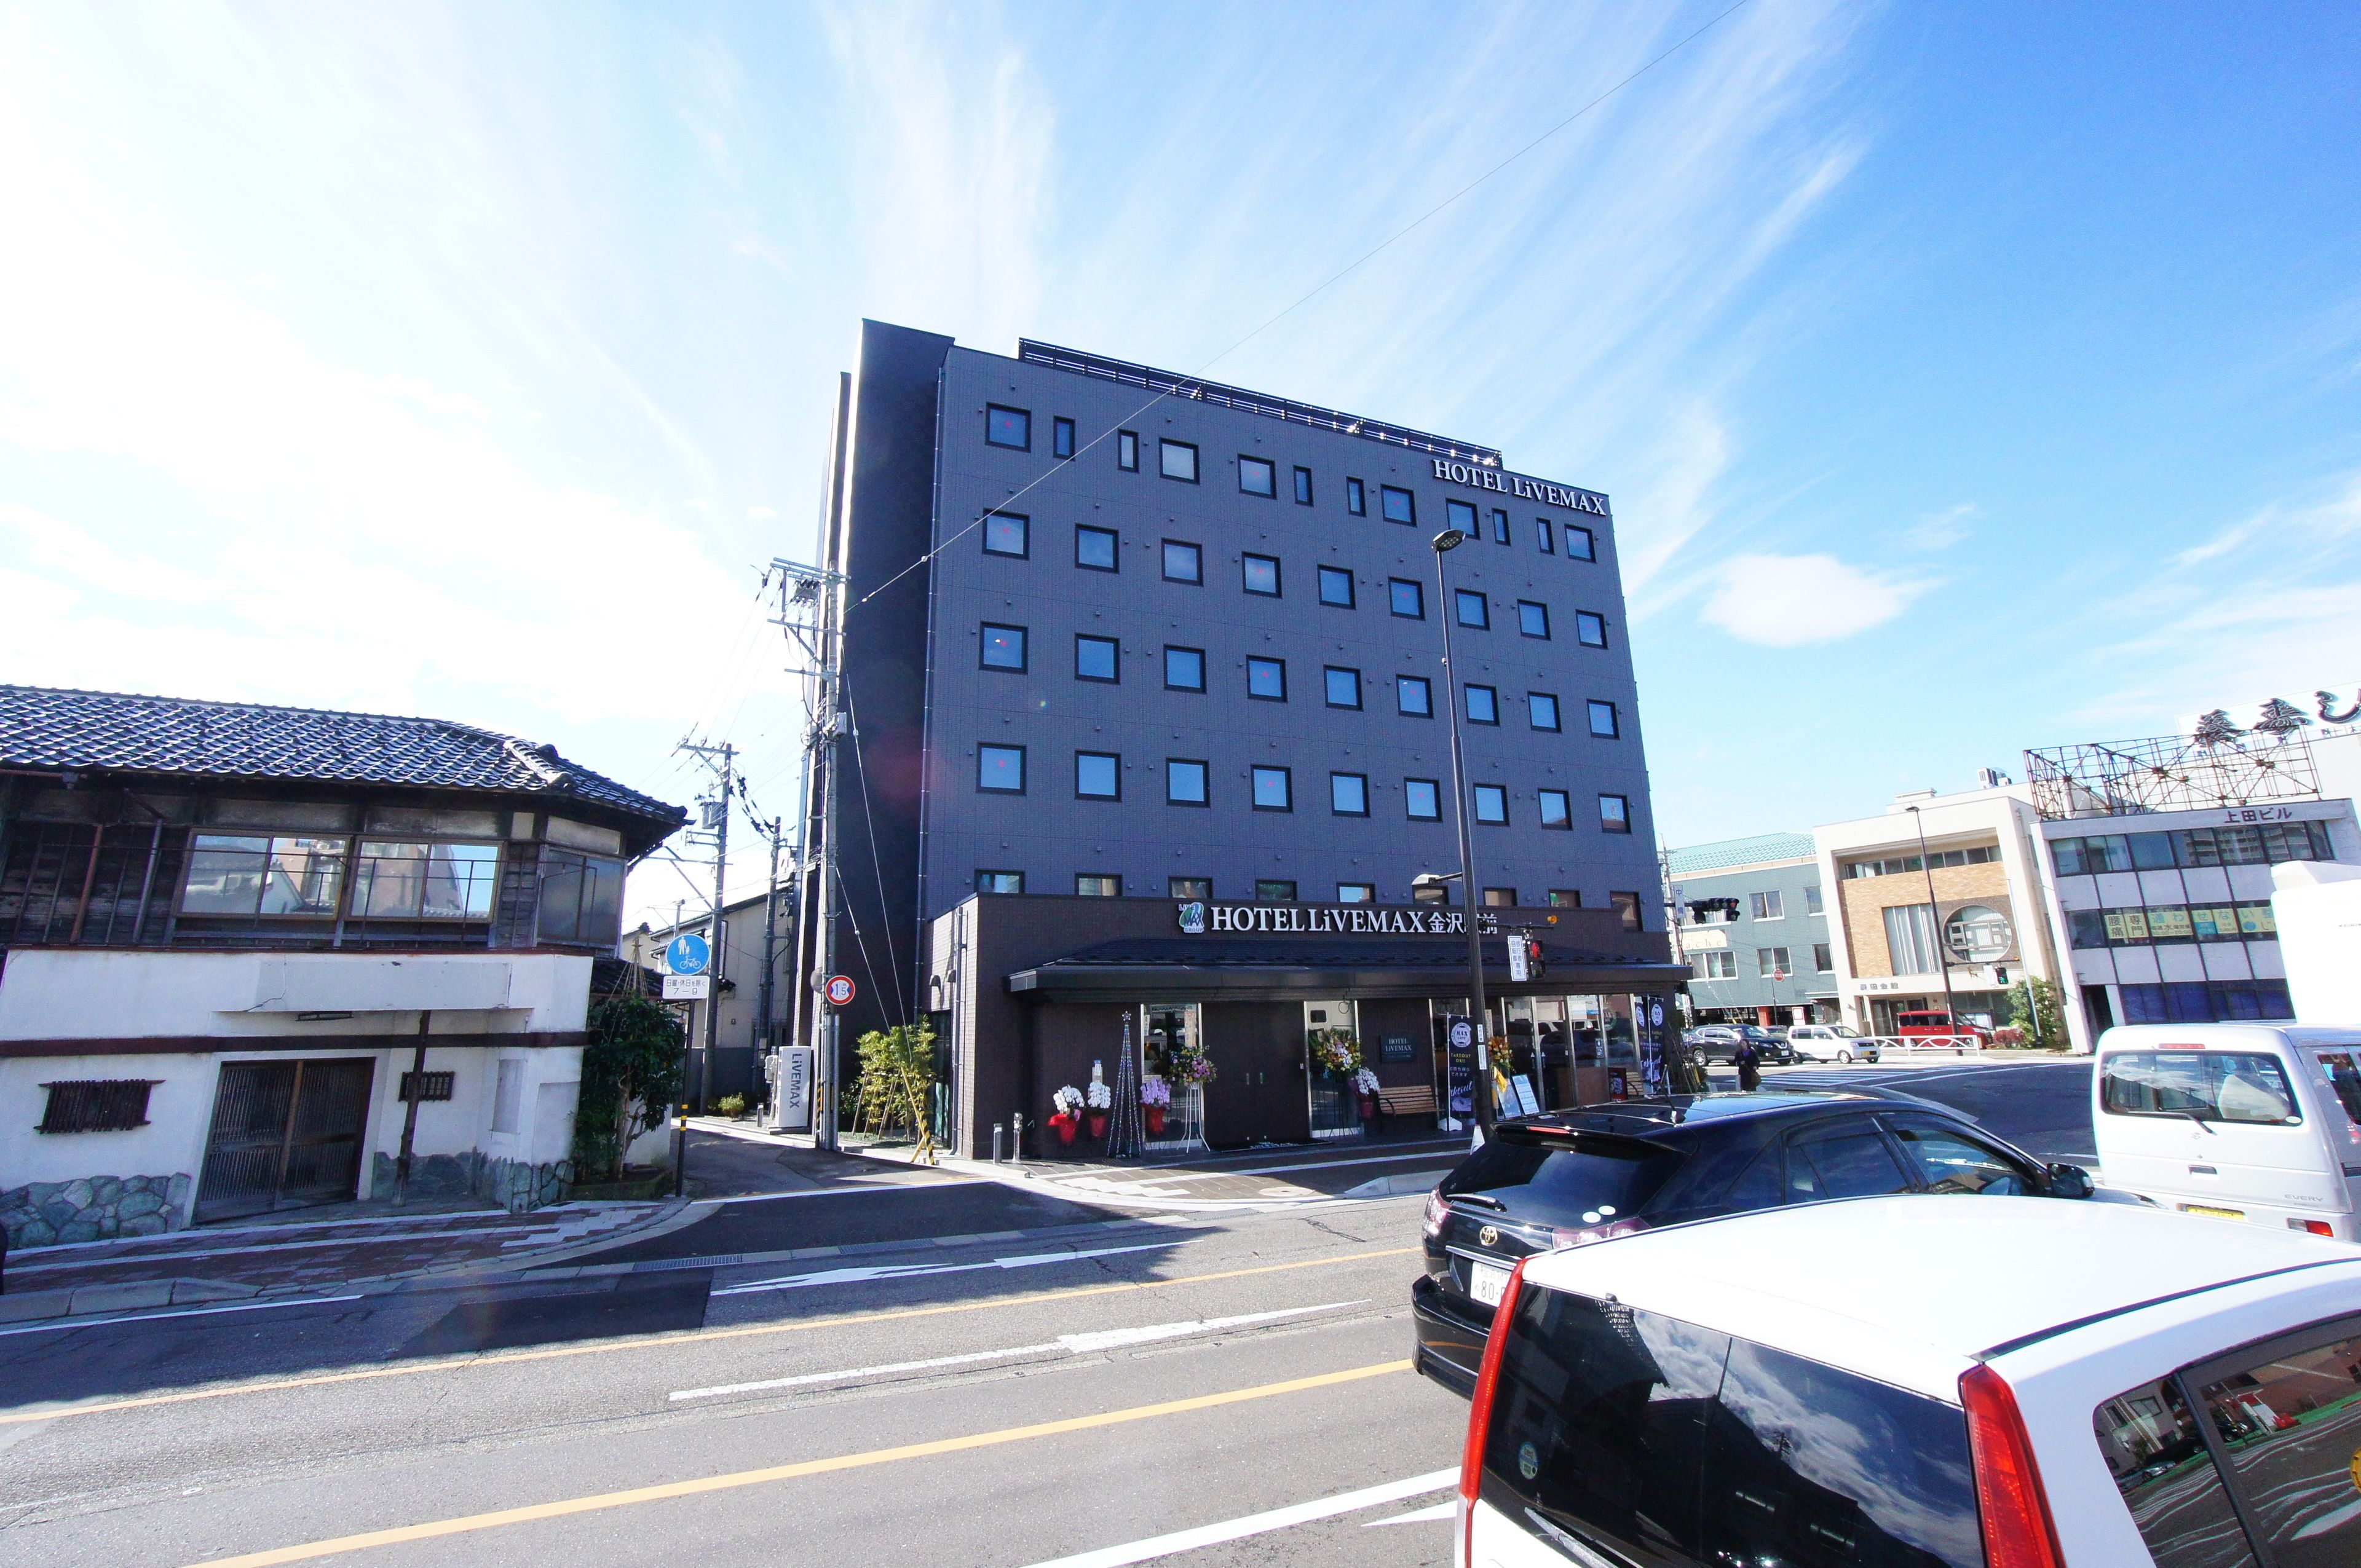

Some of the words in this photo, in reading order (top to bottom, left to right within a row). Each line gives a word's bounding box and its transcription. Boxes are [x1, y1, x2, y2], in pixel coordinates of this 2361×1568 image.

[1433, 459, 1508, 492] HOTEL
[2224, 807, 2292, 824] 上田ビル
[1211, 907, 1305, 932] HOTEL
[1307, 908, 1427, 933] LiVEMAX
[1427, 911, 1498, 935] 金沢前
[789, 1053, 802, 1109] LiVEMAX
